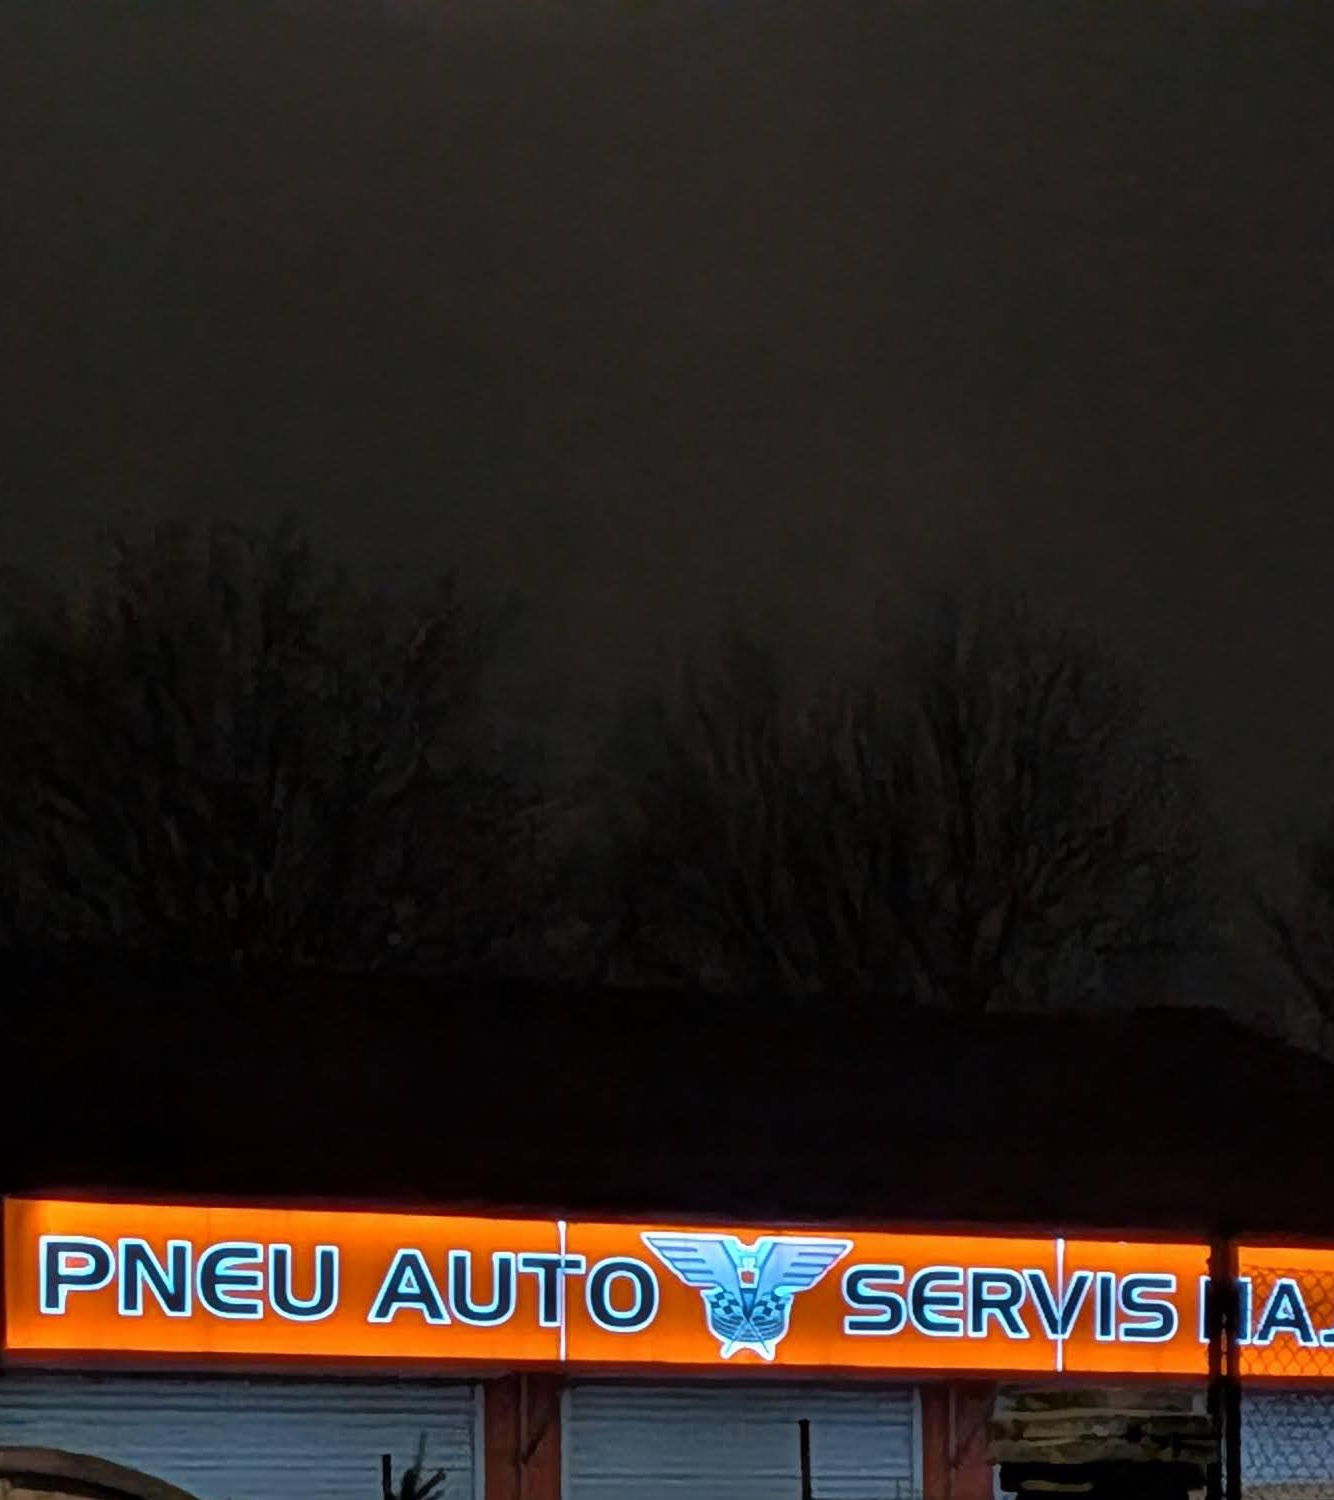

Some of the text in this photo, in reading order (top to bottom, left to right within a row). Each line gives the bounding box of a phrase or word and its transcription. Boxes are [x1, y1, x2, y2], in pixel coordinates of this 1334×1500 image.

[39, 1235, 339, 1320] PNEU
[367, 1247, 660, 1333] AUTO
[842, 1264, 1178, 1342] SERVIS
